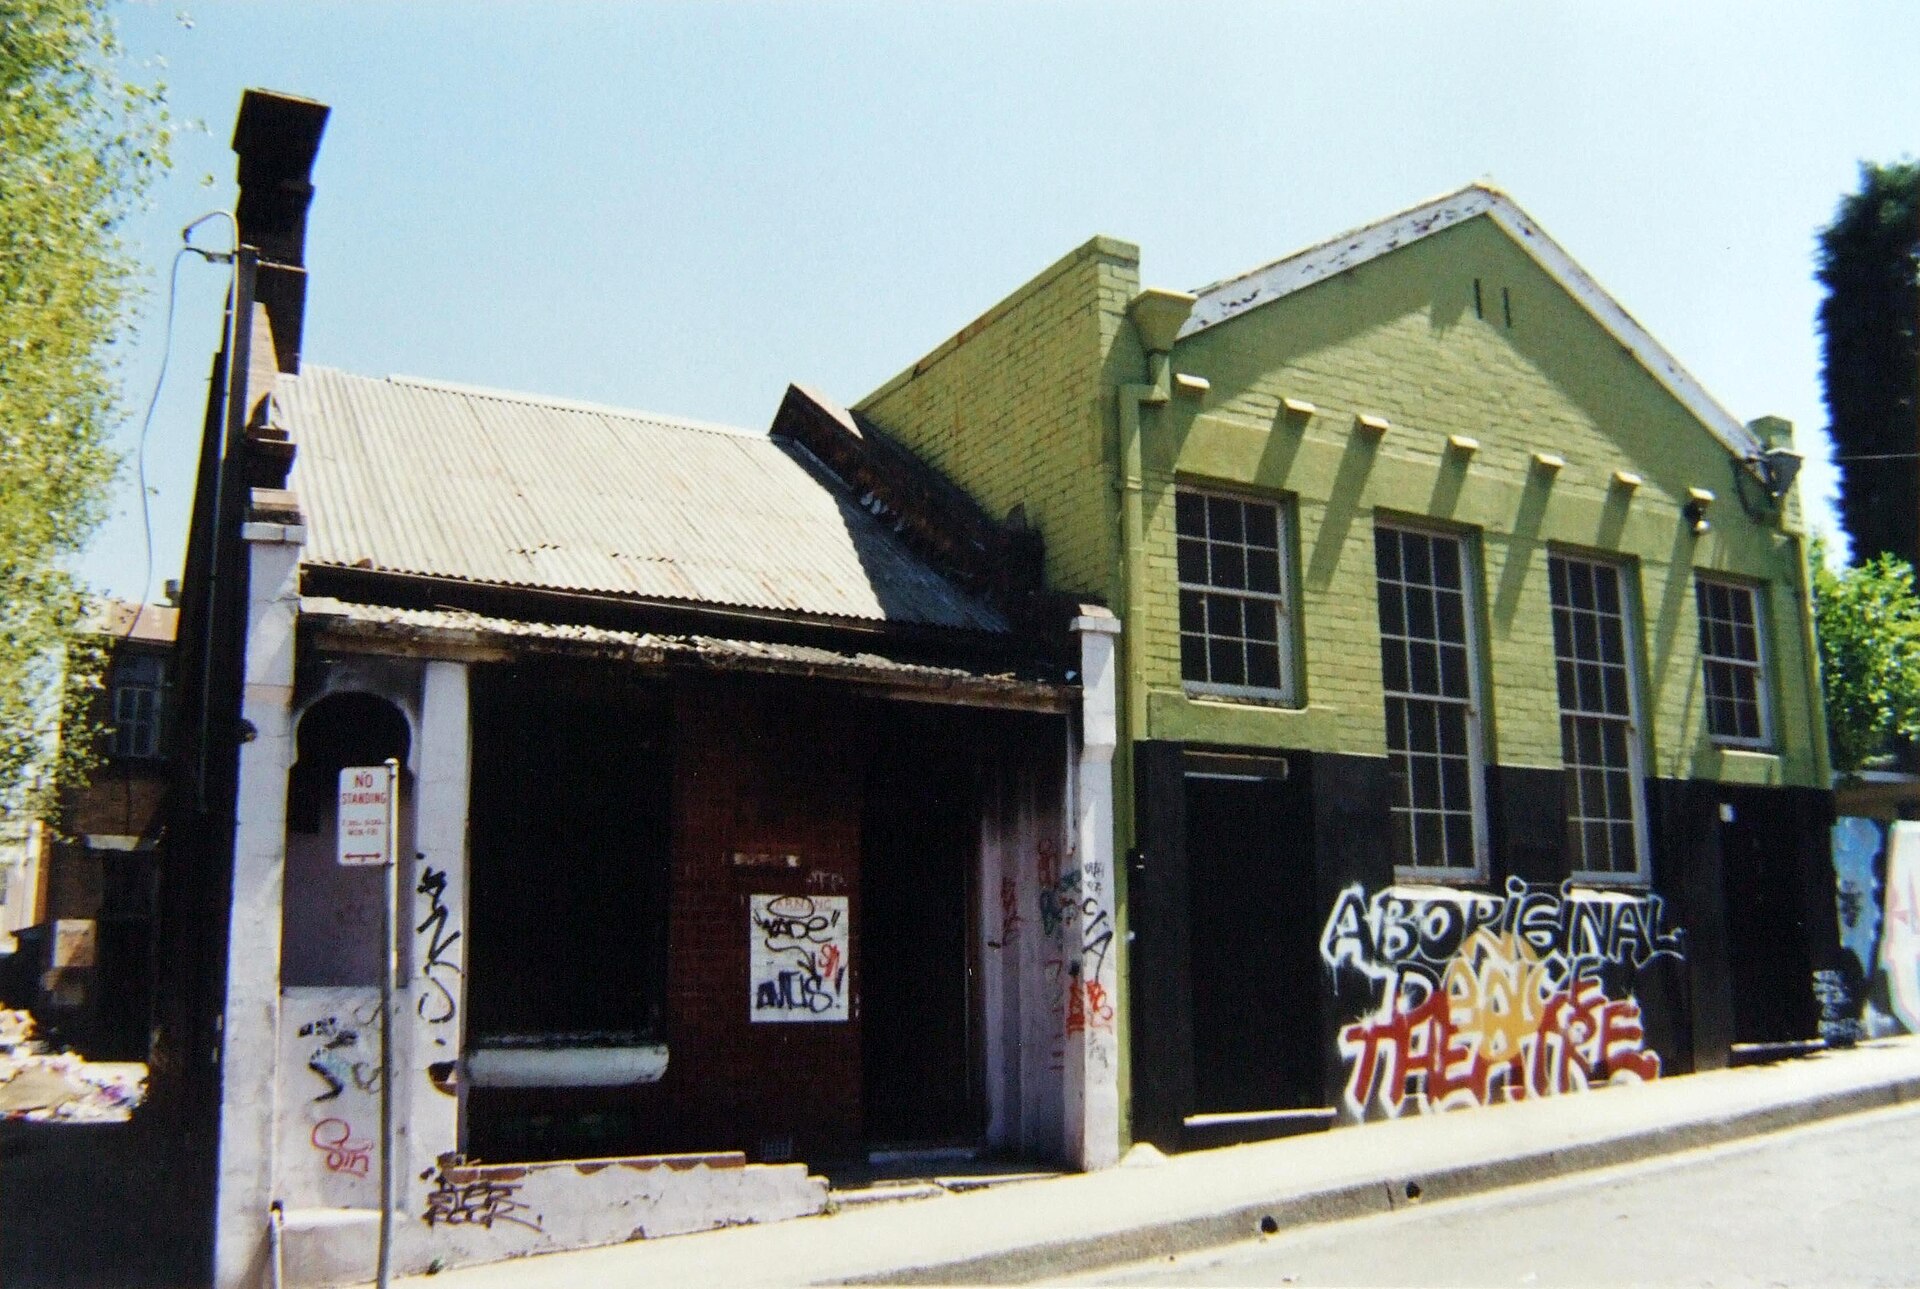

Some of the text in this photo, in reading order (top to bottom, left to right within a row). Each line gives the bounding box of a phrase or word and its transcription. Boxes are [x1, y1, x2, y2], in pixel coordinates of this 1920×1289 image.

[355, 774, 374, 788] NO
[342, 793, 386, 804] STANDING
[1338, 993, 1662, 1122] THEATRE
